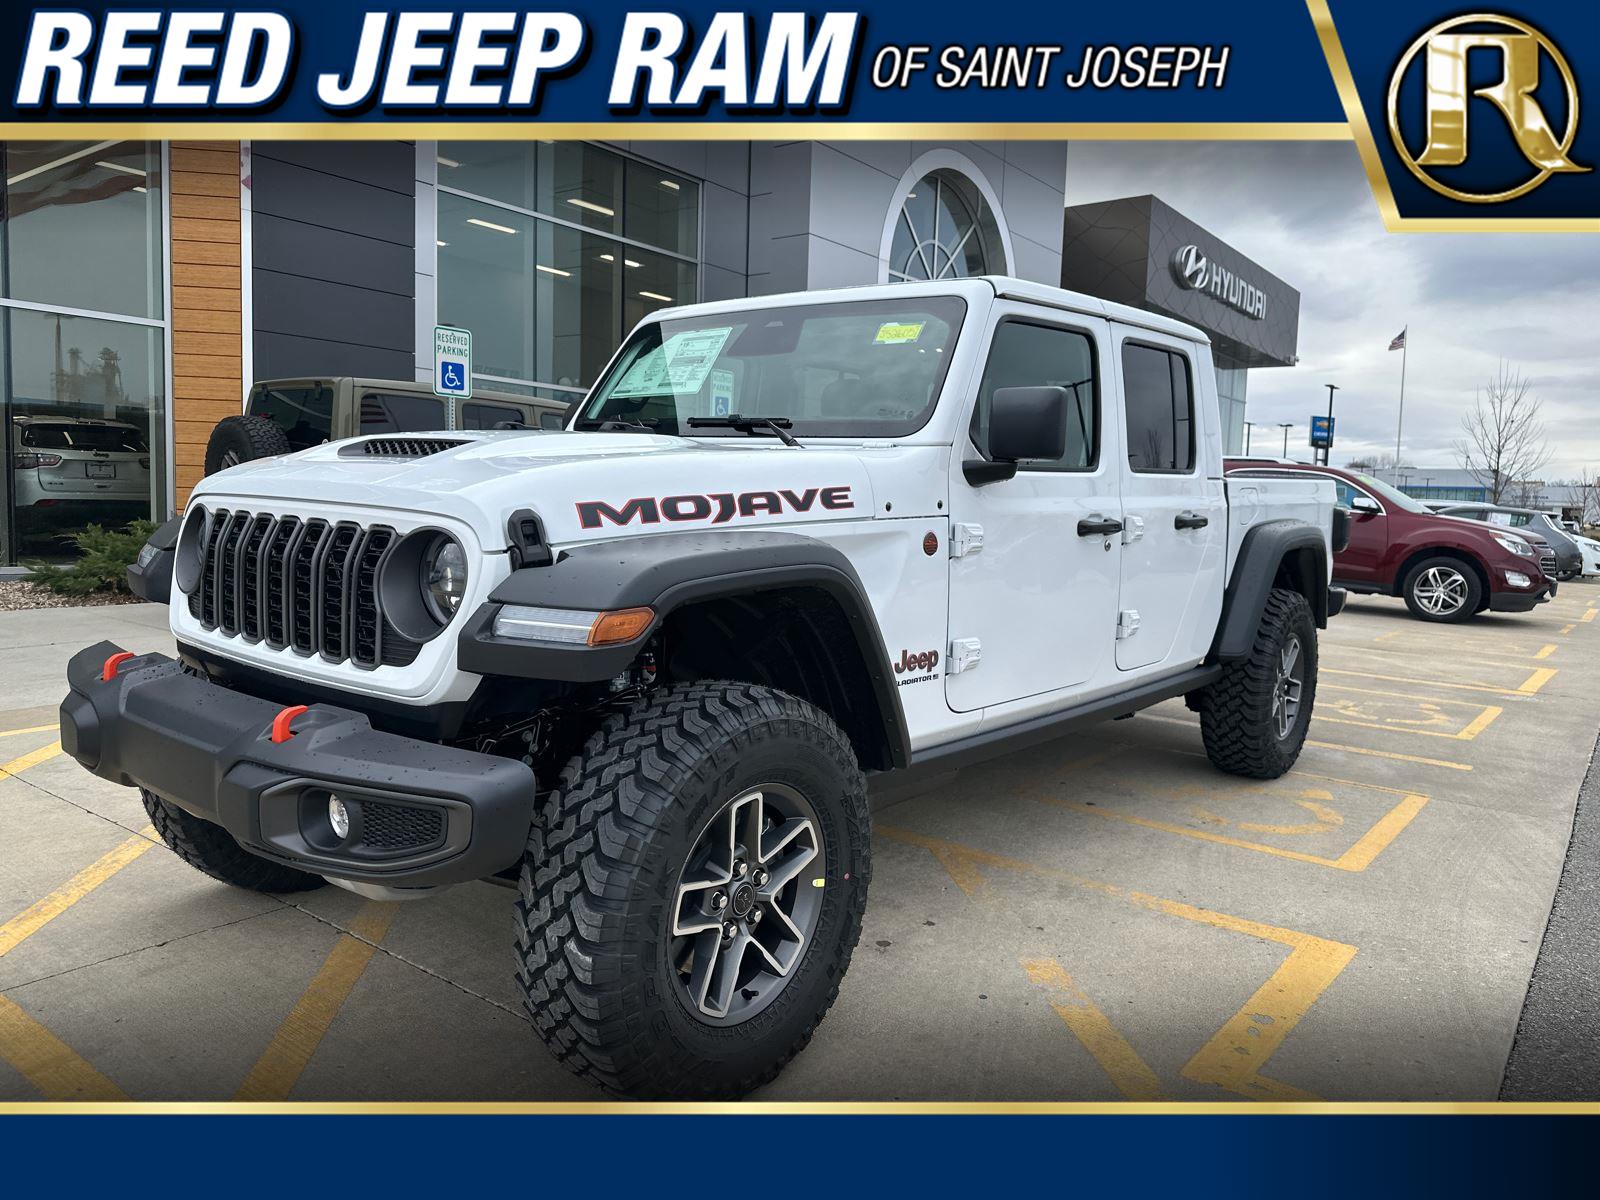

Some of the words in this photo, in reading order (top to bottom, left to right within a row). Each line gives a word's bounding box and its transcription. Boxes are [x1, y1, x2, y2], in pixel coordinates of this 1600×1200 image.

[1211, 262, 1267, 319] HYUNDAI
[437, 333, 468, 346] RESERVED
[437, 345, 468, 358] PARKING
[575, 486, 855, 530] MOJAVE
[894, 649, 939, 674] Jeep
[896, 674, 932, 687] LADIATOR
